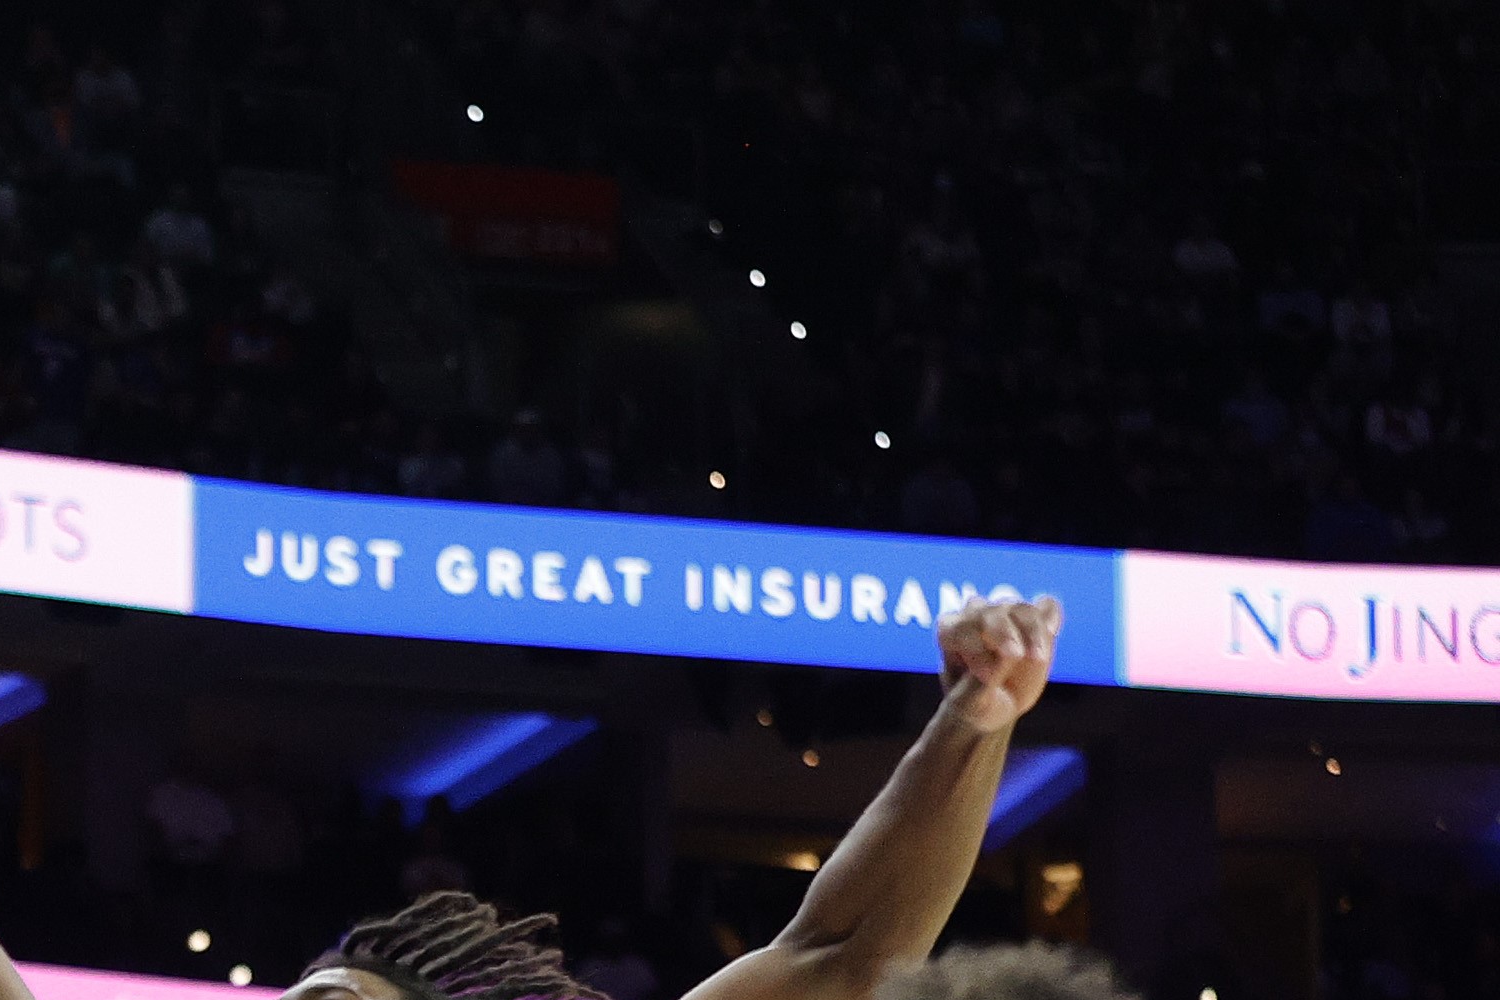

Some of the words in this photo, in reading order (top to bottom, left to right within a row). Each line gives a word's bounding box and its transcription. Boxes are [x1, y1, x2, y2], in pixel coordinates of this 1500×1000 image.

[243, 528, 403, 590] JUST
[436, 542, 650, 608] GREAT
[1227, 588, 1336, 661] NO
